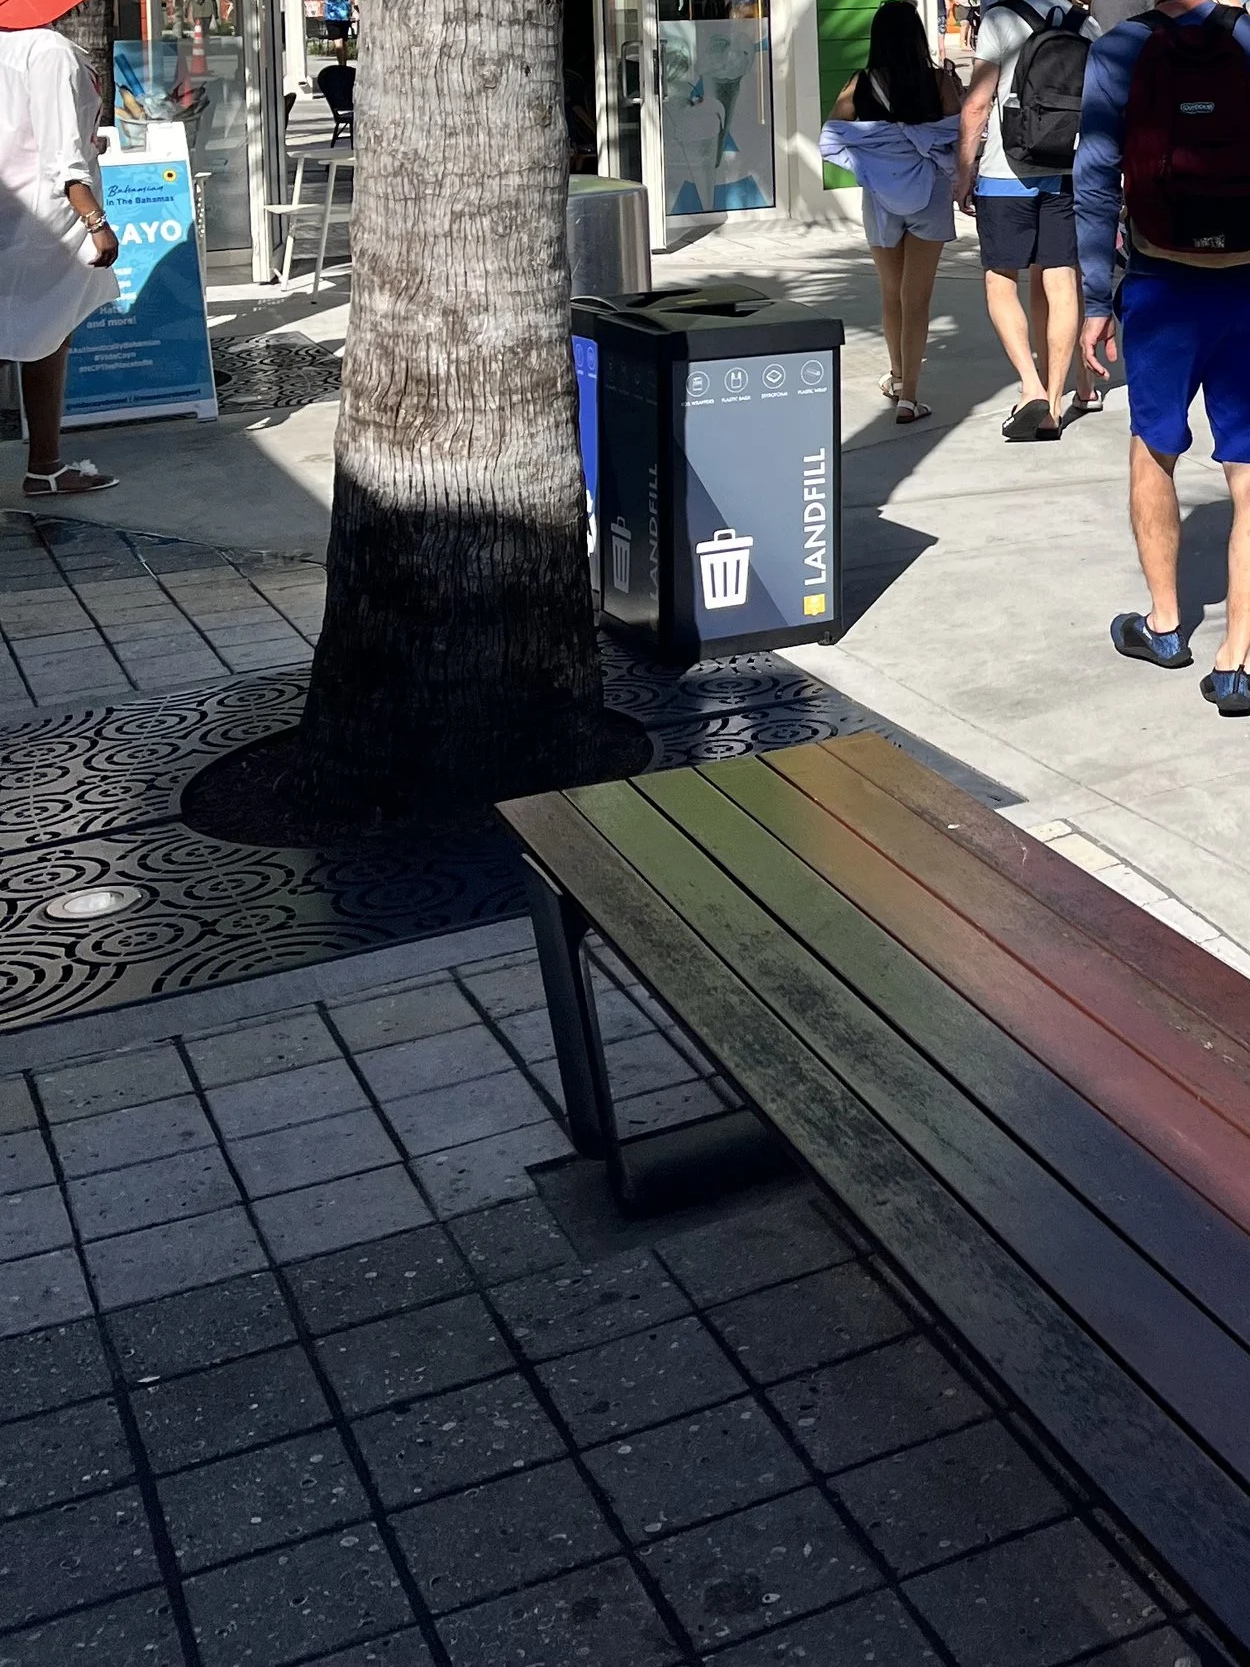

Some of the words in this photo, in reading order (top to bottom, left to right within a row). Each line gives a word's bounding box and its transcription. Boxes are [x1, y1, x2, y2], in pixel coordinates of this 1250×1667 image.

[116, 197, 133, 206] The
[135, 195, 175, 205] Bahamas
[86, 319, 106, 329] and
[107, 316, 137, 328] more!
[804, 447, 826, 586] LANDFILL
